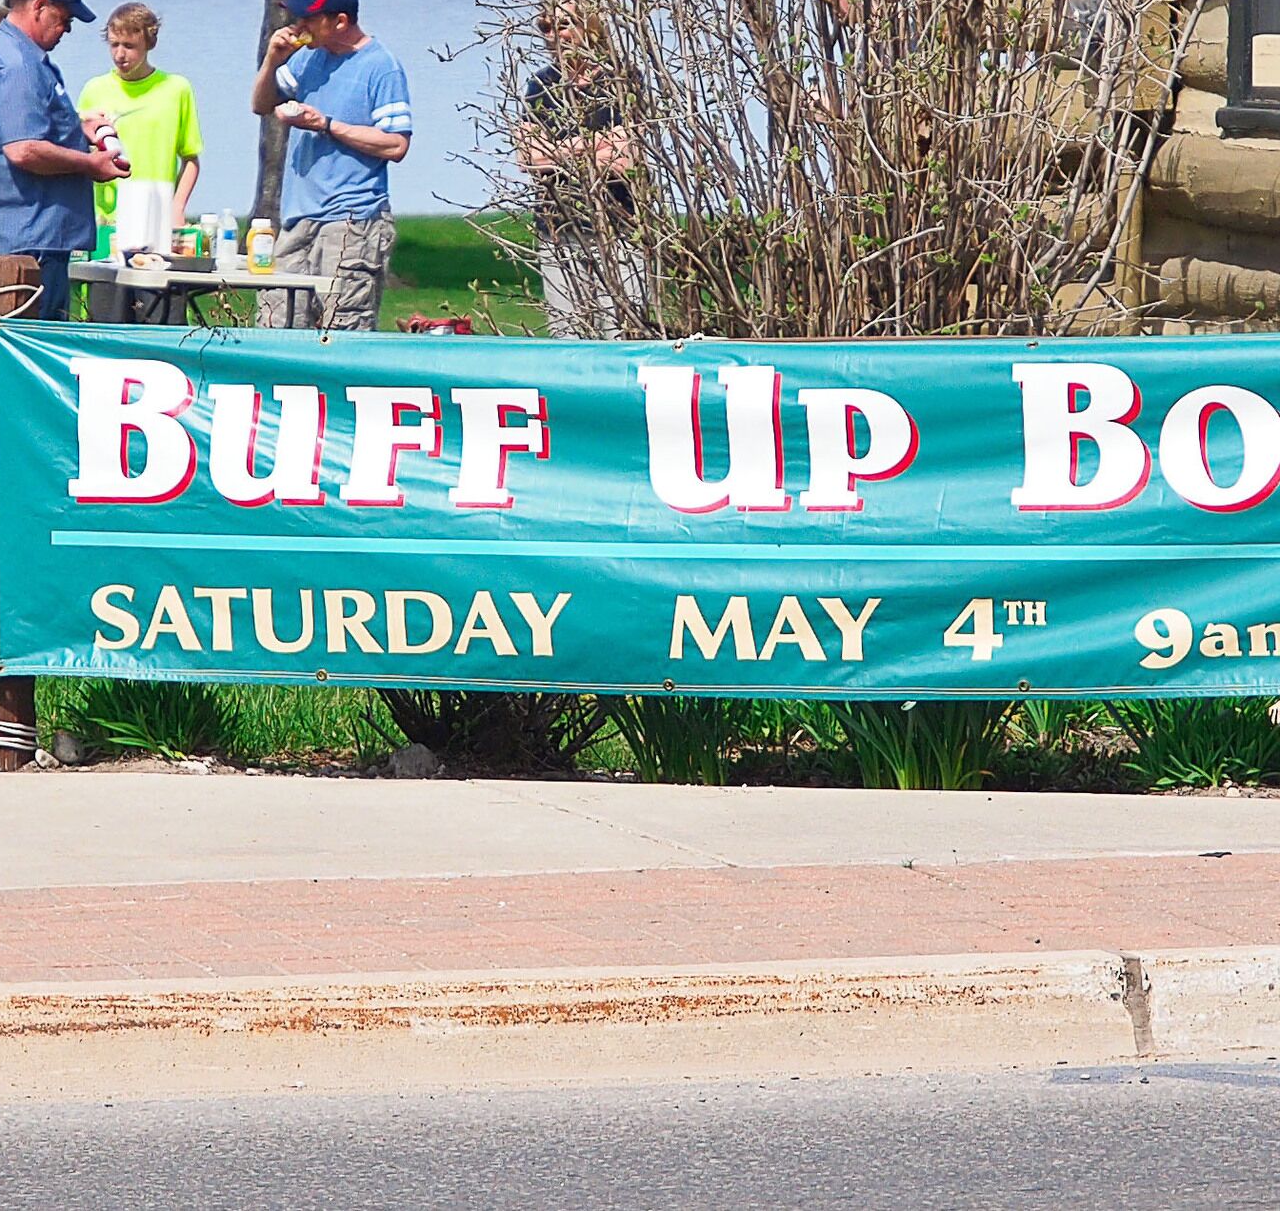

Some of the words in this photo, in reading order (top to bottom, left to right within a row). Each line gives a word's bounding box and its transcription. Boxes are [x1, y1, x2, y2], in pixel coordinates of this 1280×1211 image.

[68, 356, 550, 508] BUFF
[91, 584, 572, 657] SATURDAY
[669, 595, 882, 662] MAY
